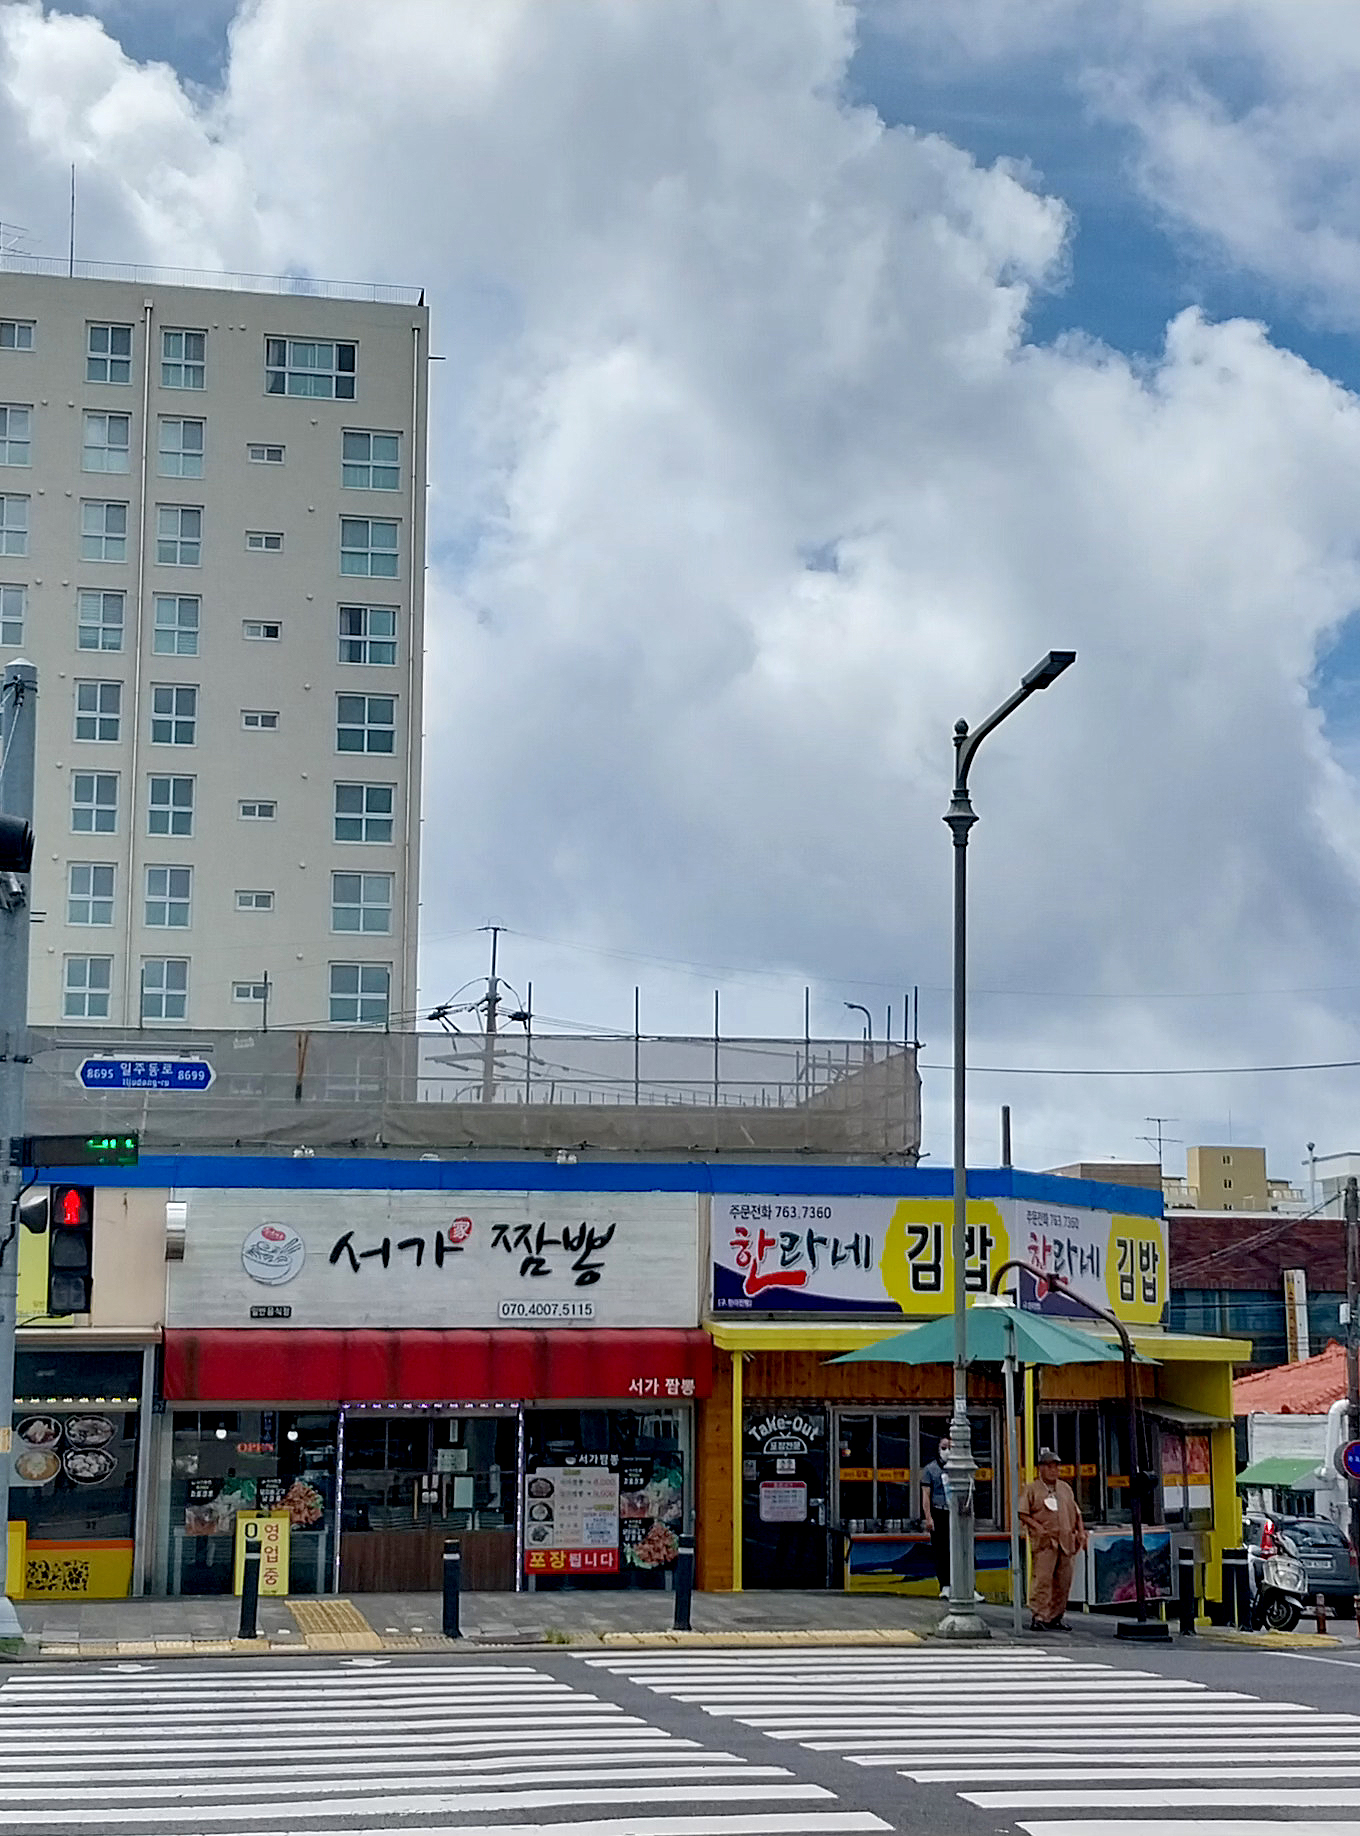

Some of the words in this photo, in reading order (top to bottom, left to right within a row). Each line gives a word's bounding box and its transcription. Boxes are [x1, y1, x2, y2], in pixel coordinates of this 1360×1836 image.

[86, 1068, 114, 1080] 8695
[120, 1062, 173, 1077] 일주동로
[177, 1070, 205, 1082] 8699
[729, 1205, 772, 1219] 주문전화
[775, 1206, 832, 1219] 763.7360
[329, 1230, 465, 1273] 서가
[490, 1221, 617, 1286] 짬뽕
[730, 1226, 872, 1295] 한라네
[906, 1222, 994, 1293] 김밥
[1116, 1238, 1159, 1304] 김밥
[501, 1302, 593, 1317] 070.4007.5115
[629, 1378, 659, 1396] 서가
[665, 1378, 695, 1396] 짬뽕
[748, 1414, 820, 1441] Take-Out
[263, 1523, 279, 1586] 영업중
[529, 1551, 615, 1569] 포장됩니다
